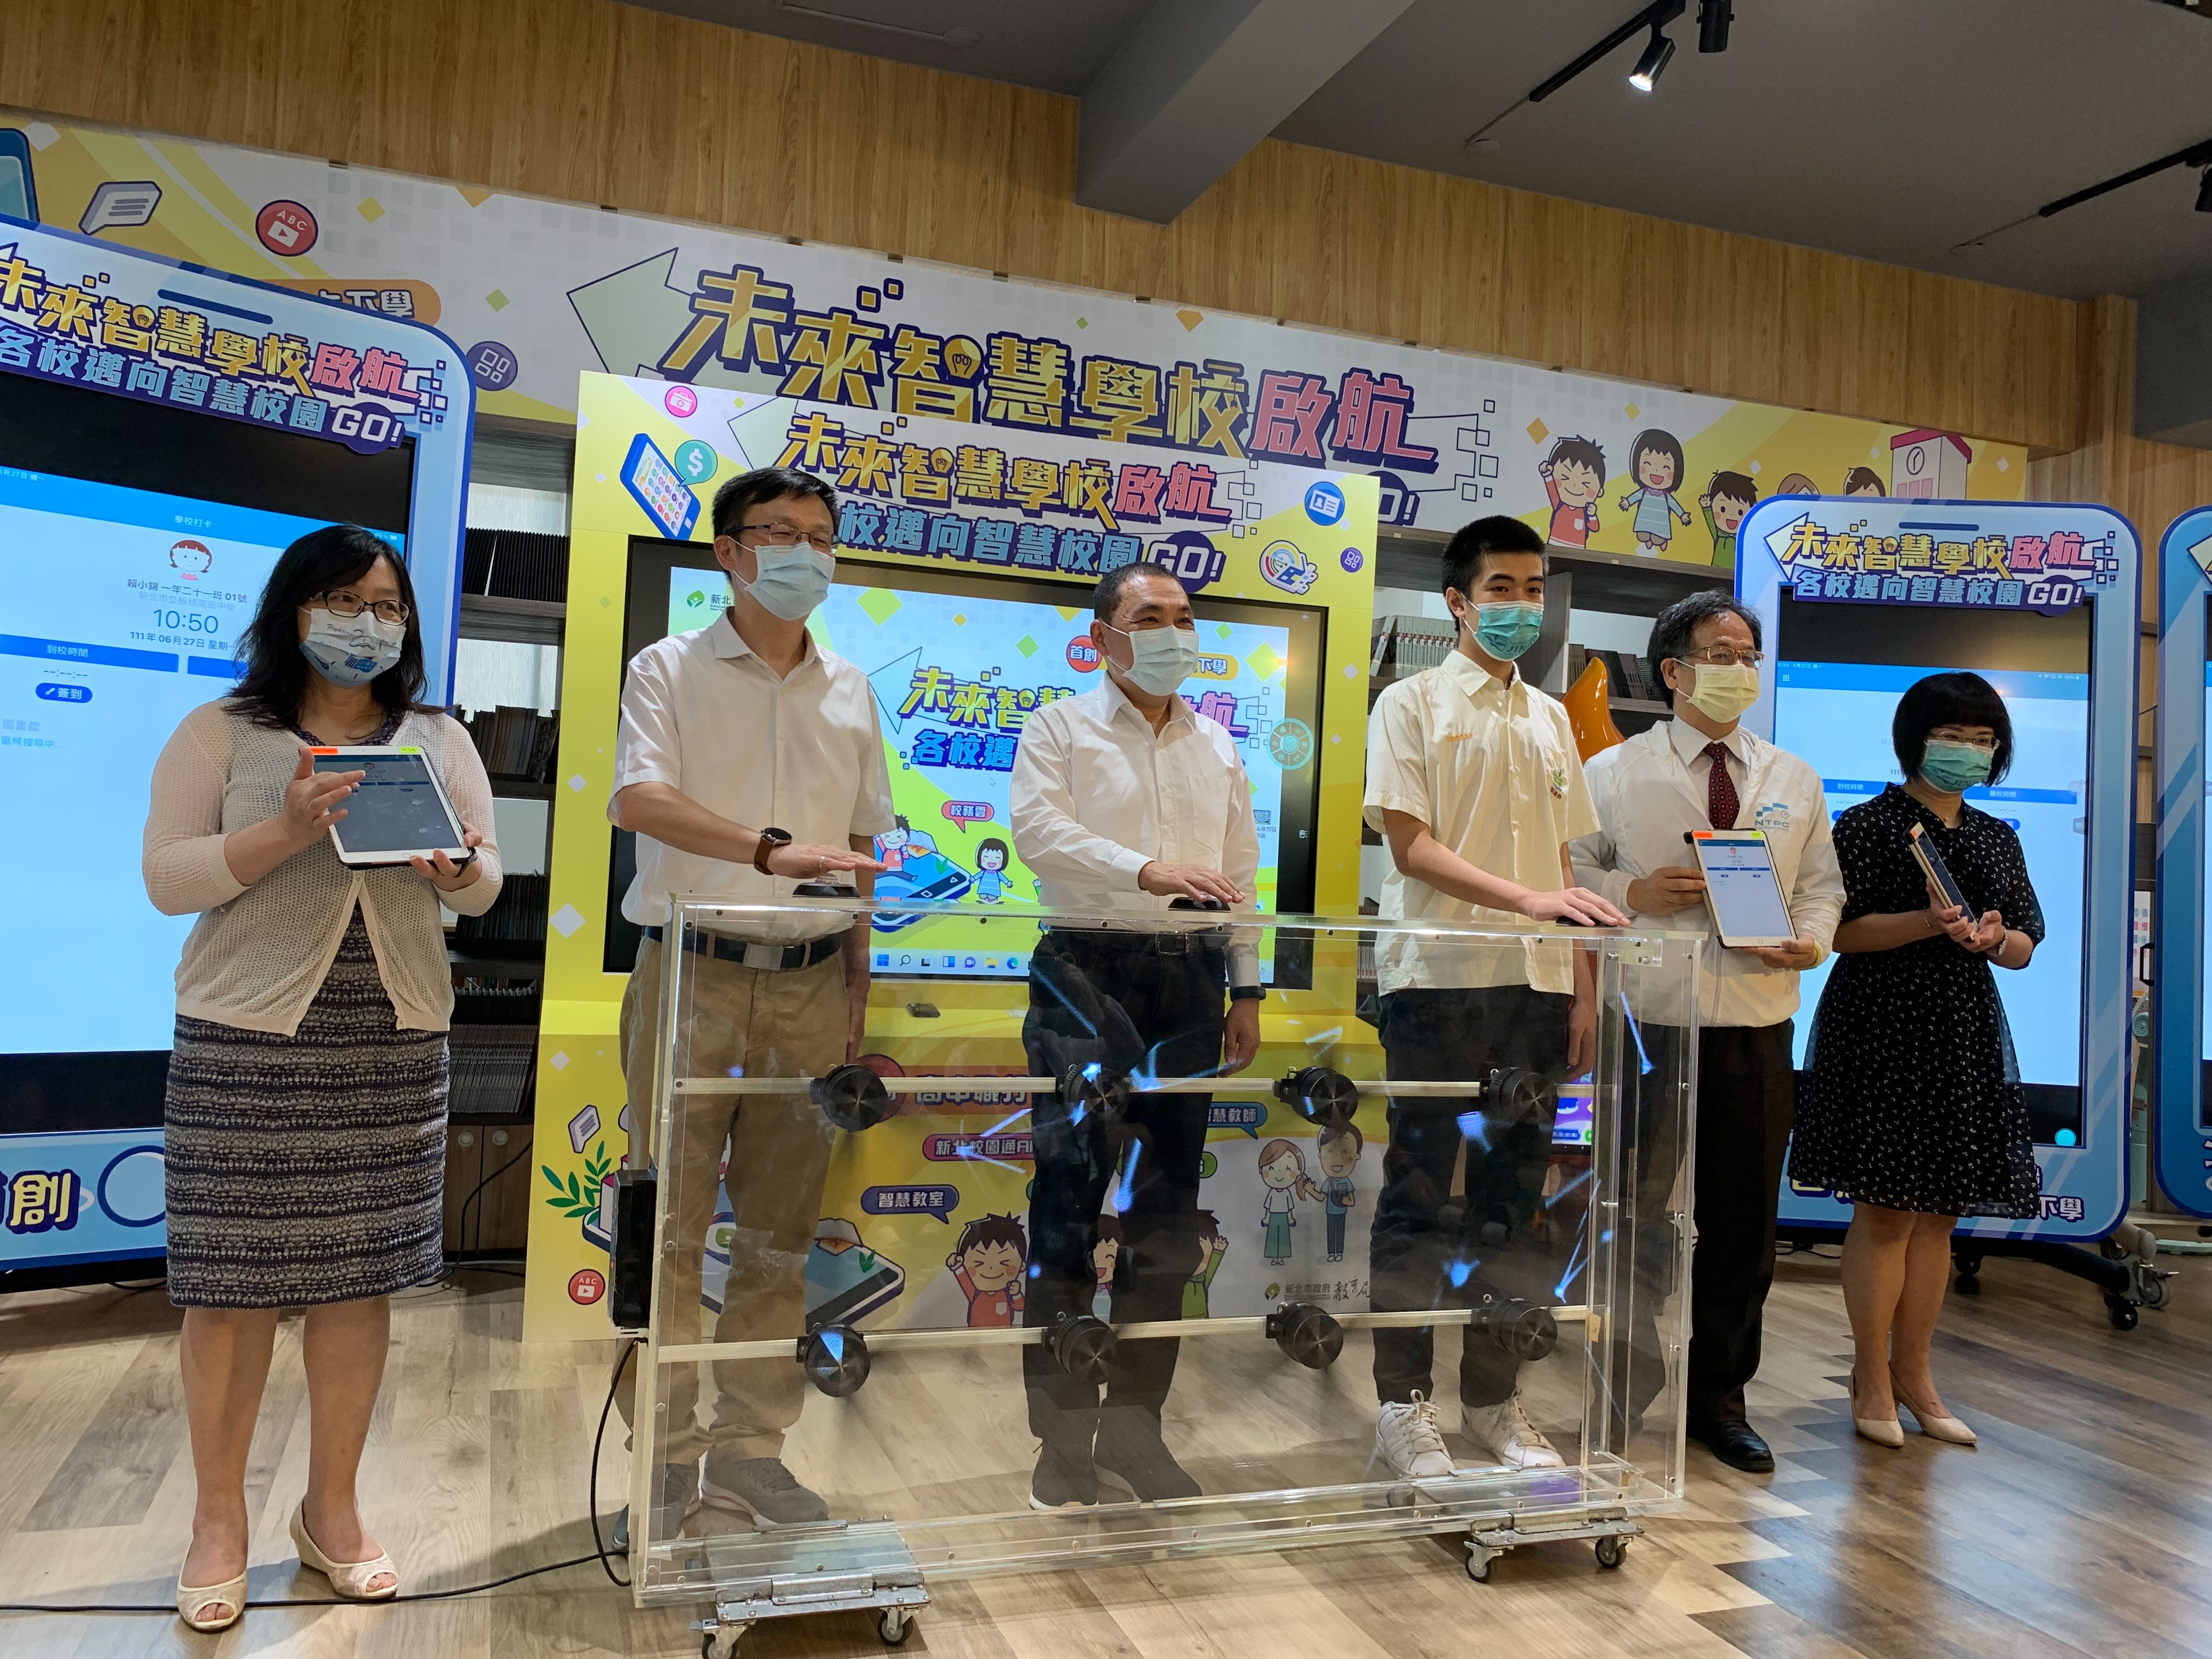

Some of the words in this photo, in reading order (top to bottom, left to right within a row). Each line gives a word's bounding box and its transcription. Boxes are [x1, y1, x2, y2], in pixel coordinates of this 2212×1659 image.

[277, 209, 308, 231] ABC
[174, 515, 213, 528] 學校打卡
[1783, 523, 2094, 579] 未來智慧學校啟航
[154, 609, 218, 634] 10:50
[47, 645, 88, 658] 到校時間
[1070, 645, 1097, 662] 首創
[58, 687, 82, 700] 簽到
[950, 804, 987, 818] 校務雲
[1208, 1108, 1256, 1122] 慧教師
